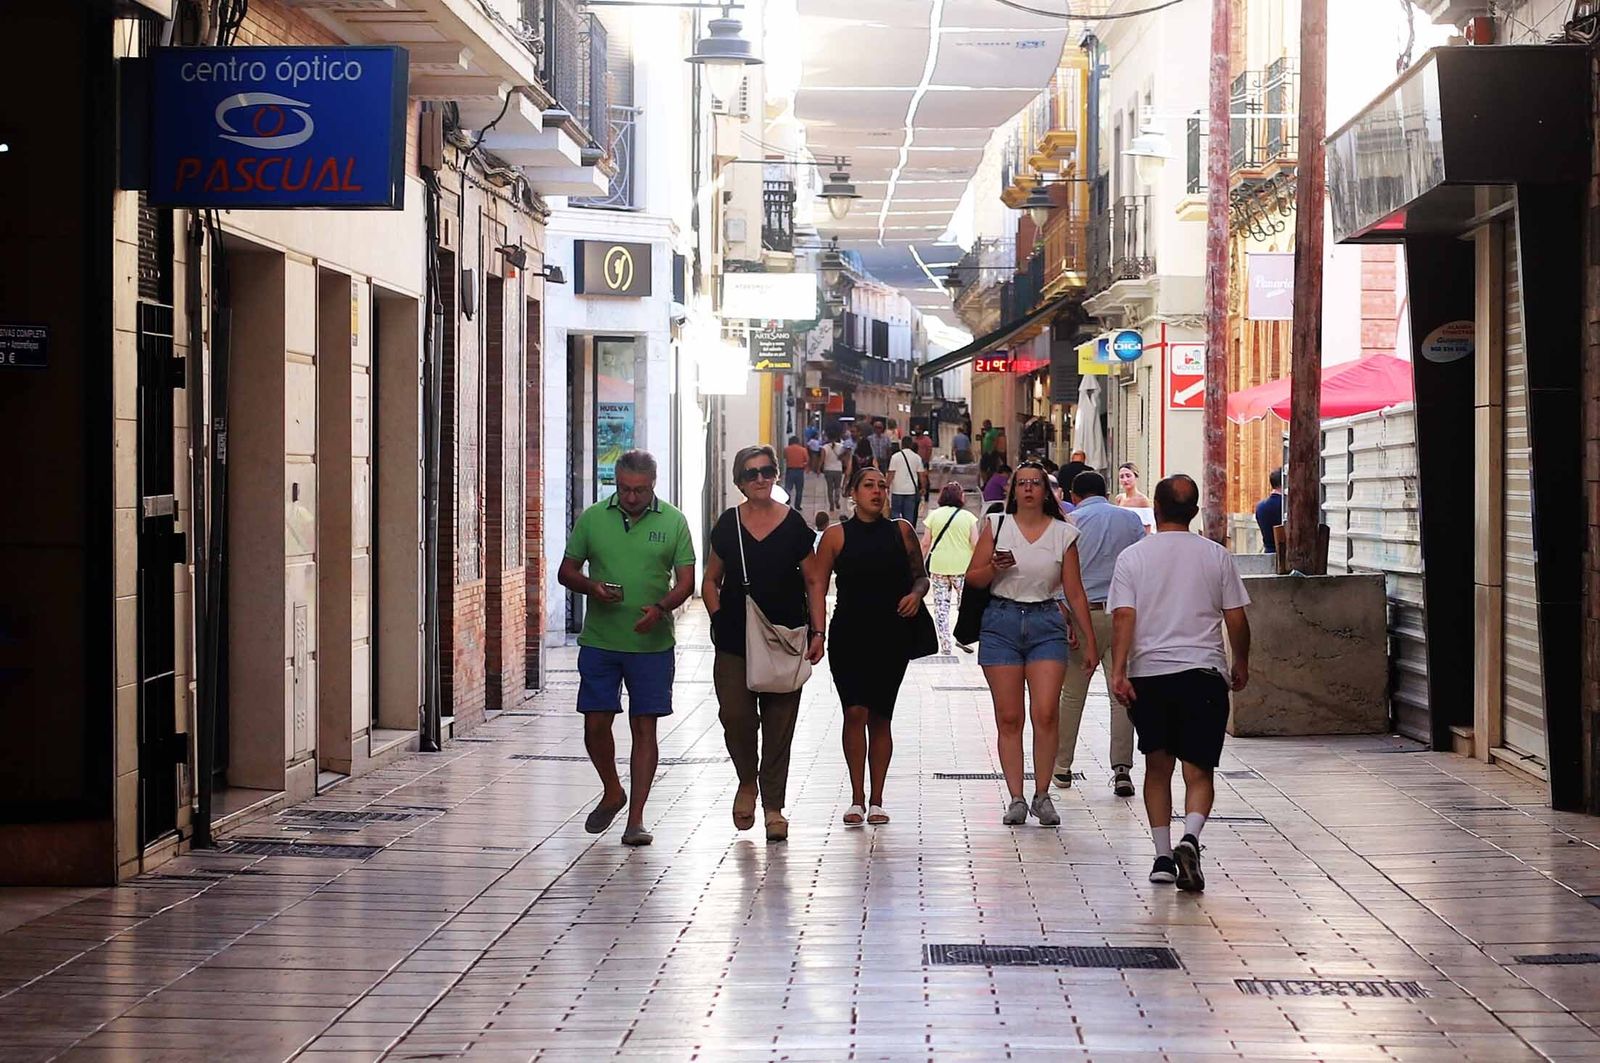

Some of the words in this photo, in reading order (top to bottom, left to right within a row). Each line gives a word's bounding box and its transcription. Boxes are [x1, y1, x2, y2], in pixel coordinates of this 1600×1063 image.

[180, 56, 267, 82] centro
[275, 55, 362, 87] óptico
[174, 156, 364, 193] PASCUAL
